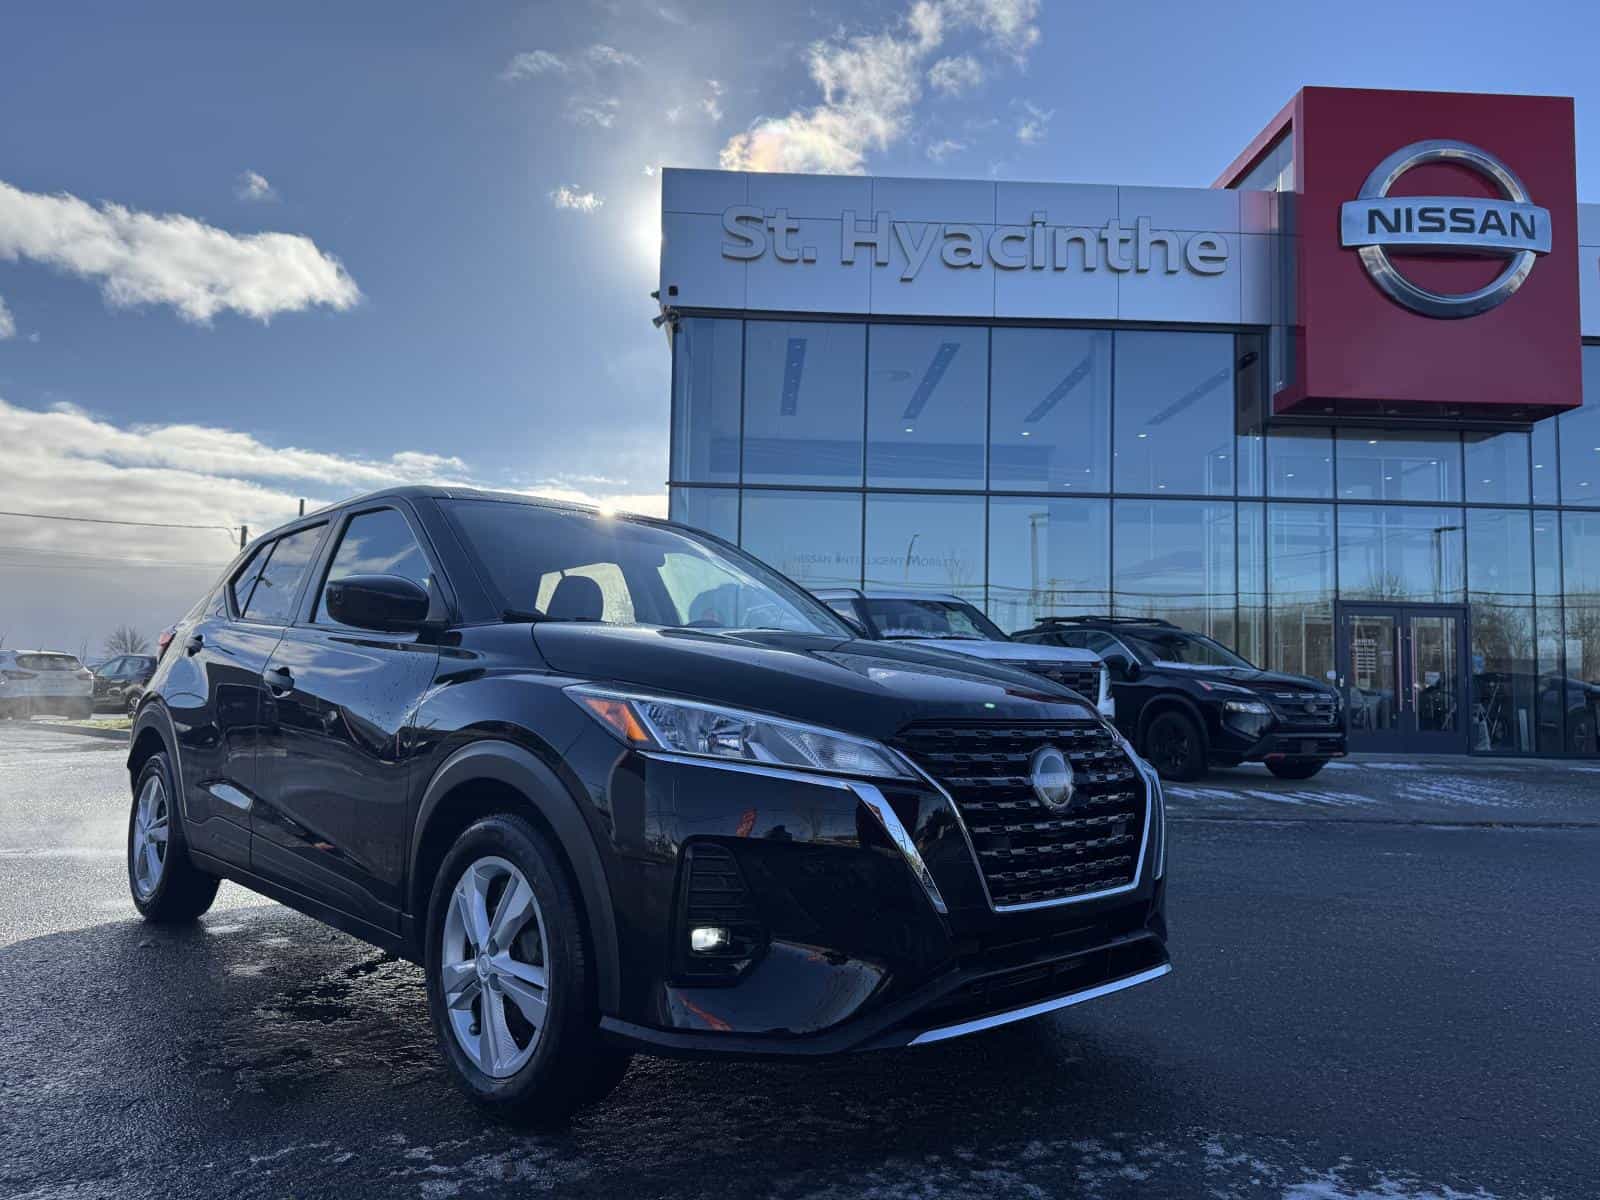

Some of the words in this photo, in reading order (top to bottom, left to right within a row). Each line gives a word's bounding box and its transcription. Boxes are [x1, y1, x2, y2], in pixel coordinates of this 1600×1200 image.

[721, 204, 817, 262] St.
[840, 208, 1230, 282] Hyacinthe
[1367, 207, 1536, 240] NISSAN
